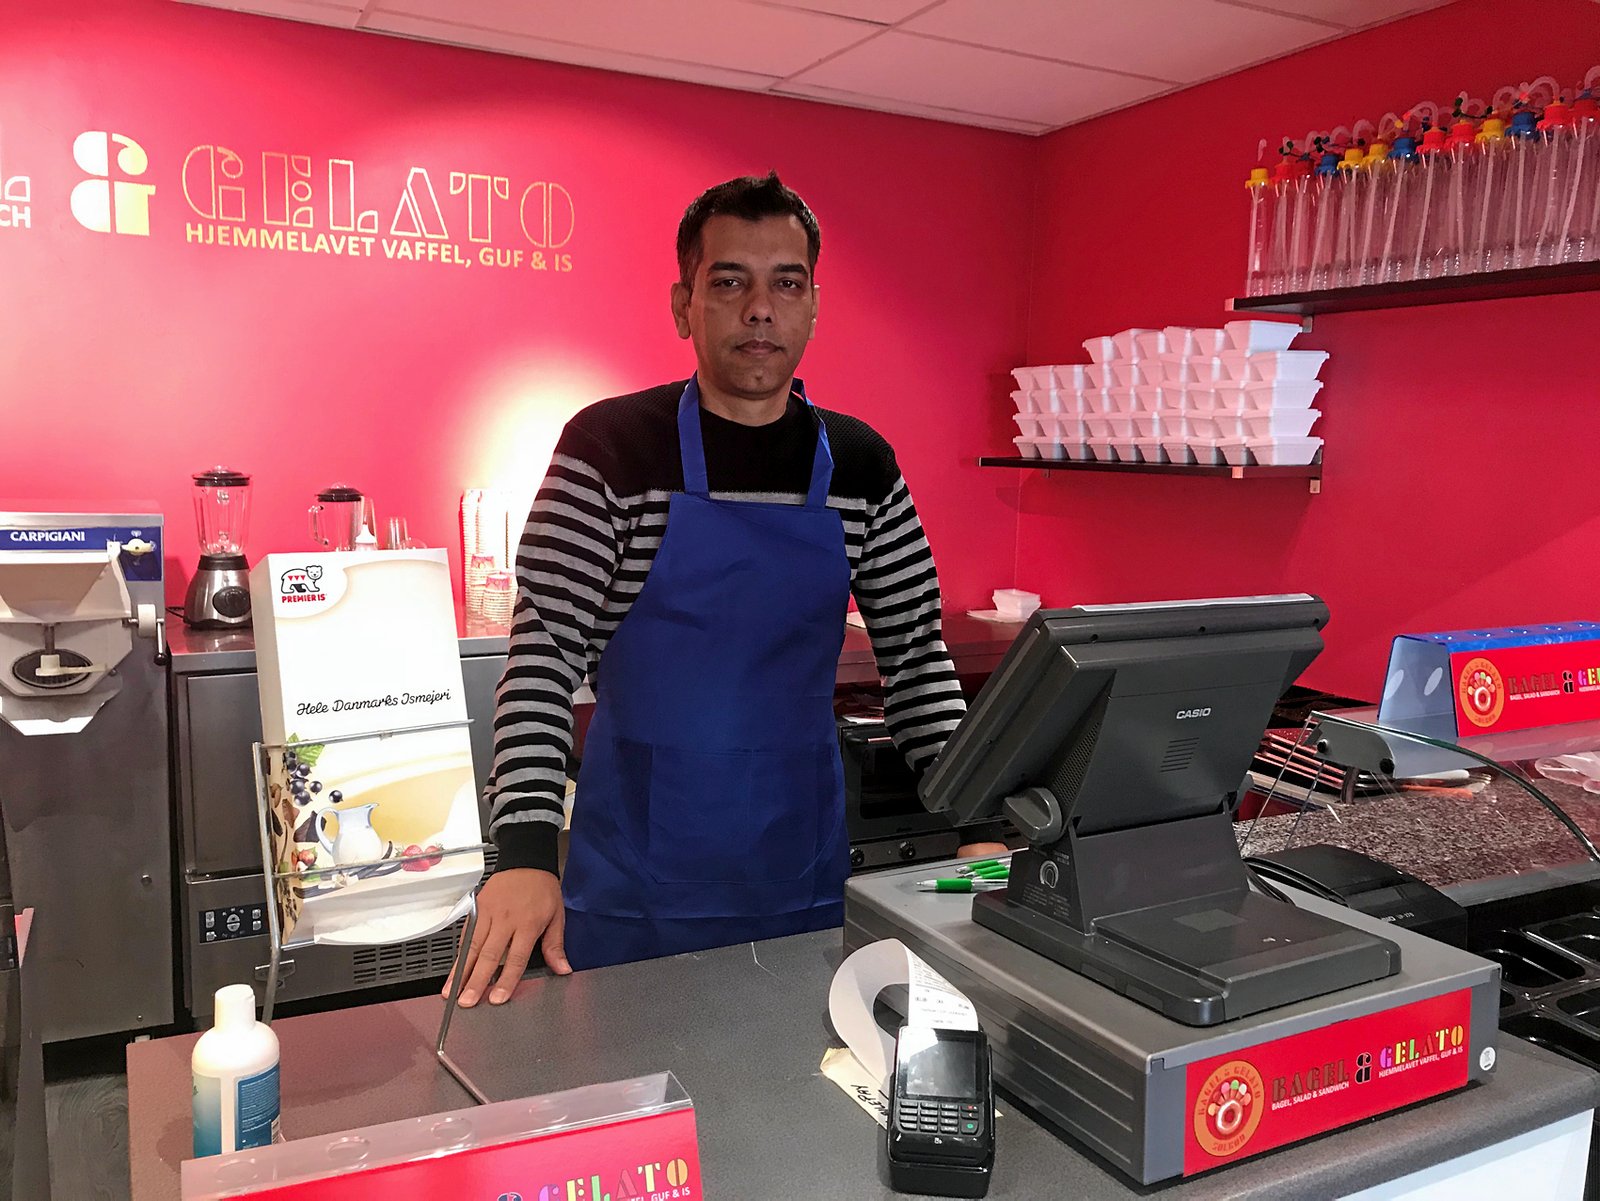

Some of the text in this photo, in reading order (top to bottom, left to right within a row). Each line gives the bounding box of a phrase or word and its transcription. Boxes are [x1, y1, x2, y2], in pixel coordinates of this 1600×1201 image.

[182, 144, 575, 249] GELATO
[185, 222, 573, 273] HJEMMELAVET VAFFEL, GUF & IS
[10, 530, 86, 542] CARPIGIANI
[281, 593, 326, 603] PREMIER IS
[1507, 673, 1559, 695] BAGEL
[297, 688, 451, 716] Hele Danmarks Ismejeri
[1176, 707, 1212, 719] CASIO
[1271, 1024, 1464, 1103] BAGEL & GELATO
[1379, 1059, 1419, 1078] HJEMMELAVET
[1271, 1098, 1293, 1111] BAGEL,
[1293, 1093, 1312, 1105] SALAD
[1318, 1081, 1349, 1098] SANDWICH
[682, 1186, 691, 1196] IS
